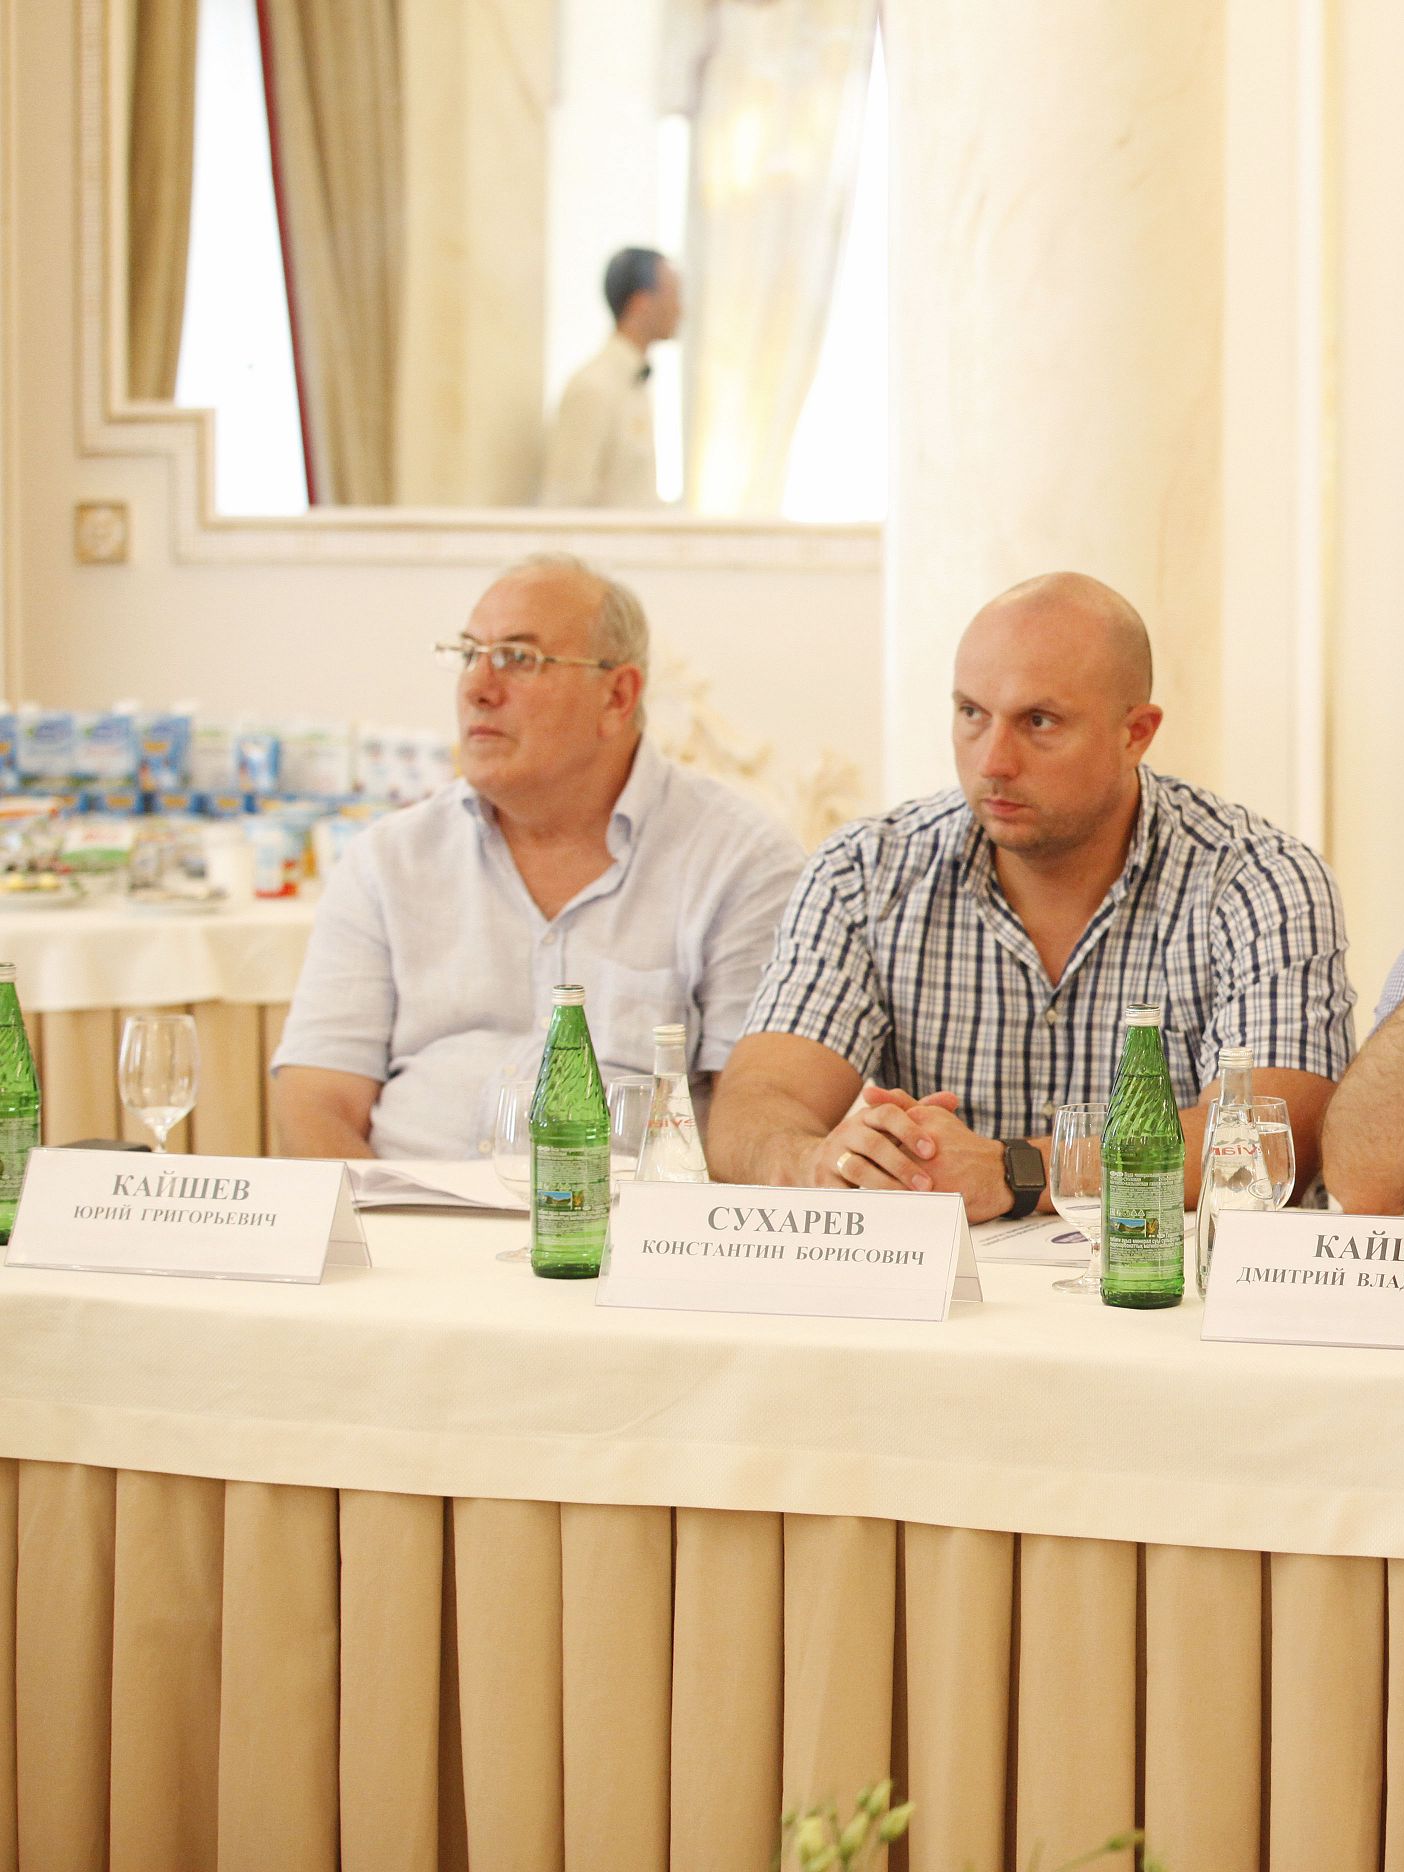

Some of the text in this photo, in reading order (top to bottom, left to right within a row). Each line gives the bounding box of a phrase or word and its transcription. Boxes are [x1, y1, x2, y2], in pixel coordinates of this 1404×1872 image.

[112, 1169, 251, 1201] КАЙШЕВ
[73, 1203, 277, 1227] ЮРИЙ ГРИГОРЬЕВИЧ
[707, 1206, 865, 1236] СУХАРЕВ
[642, 1239, 925, 1266] КОНСТАНТИН БОРИСОВИЧ
[1235, 1266, 1345, 1286] ДМИТРИЙ
